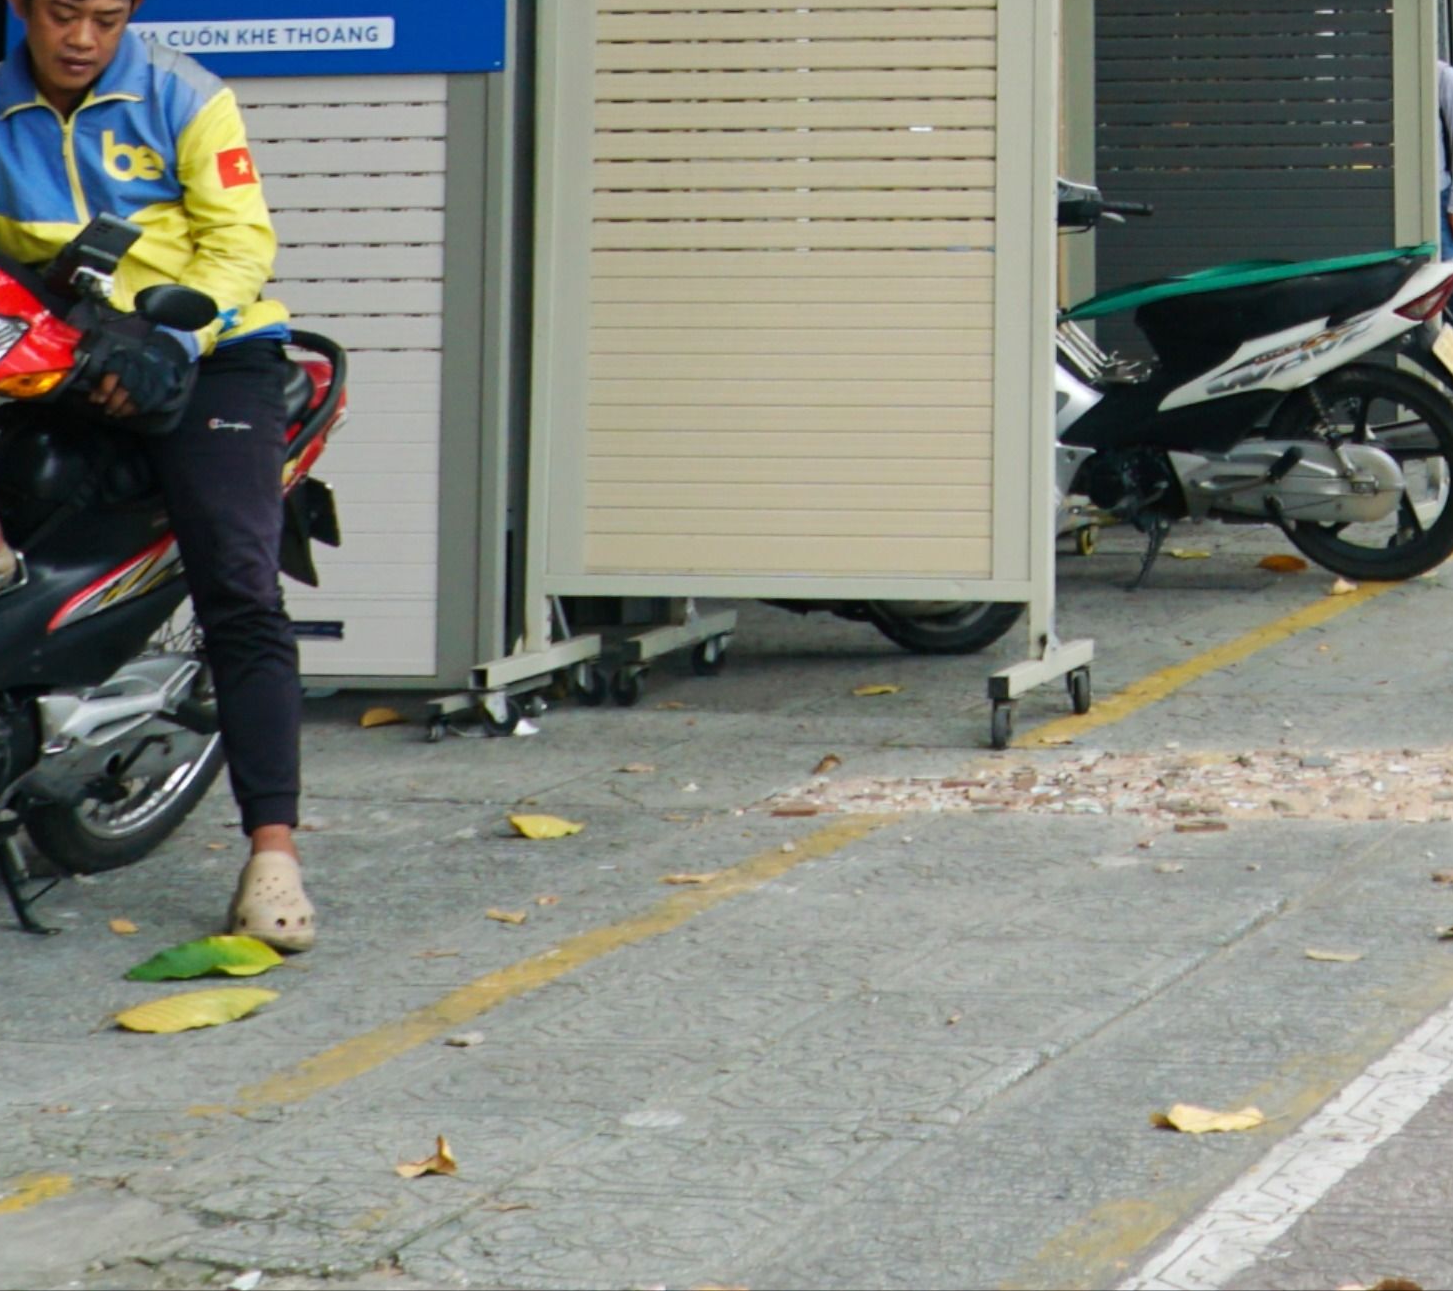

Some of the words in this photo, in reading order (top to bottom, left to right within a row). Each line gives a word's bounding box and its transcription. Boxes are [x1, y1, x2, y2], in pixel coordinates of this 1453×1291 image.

[167, 26, 230, 47] CUỐN
[236, 27, 278, 45] KHE
[284, 23, 379, 44] THOÁNG
[101, 131, 164, 182] be
